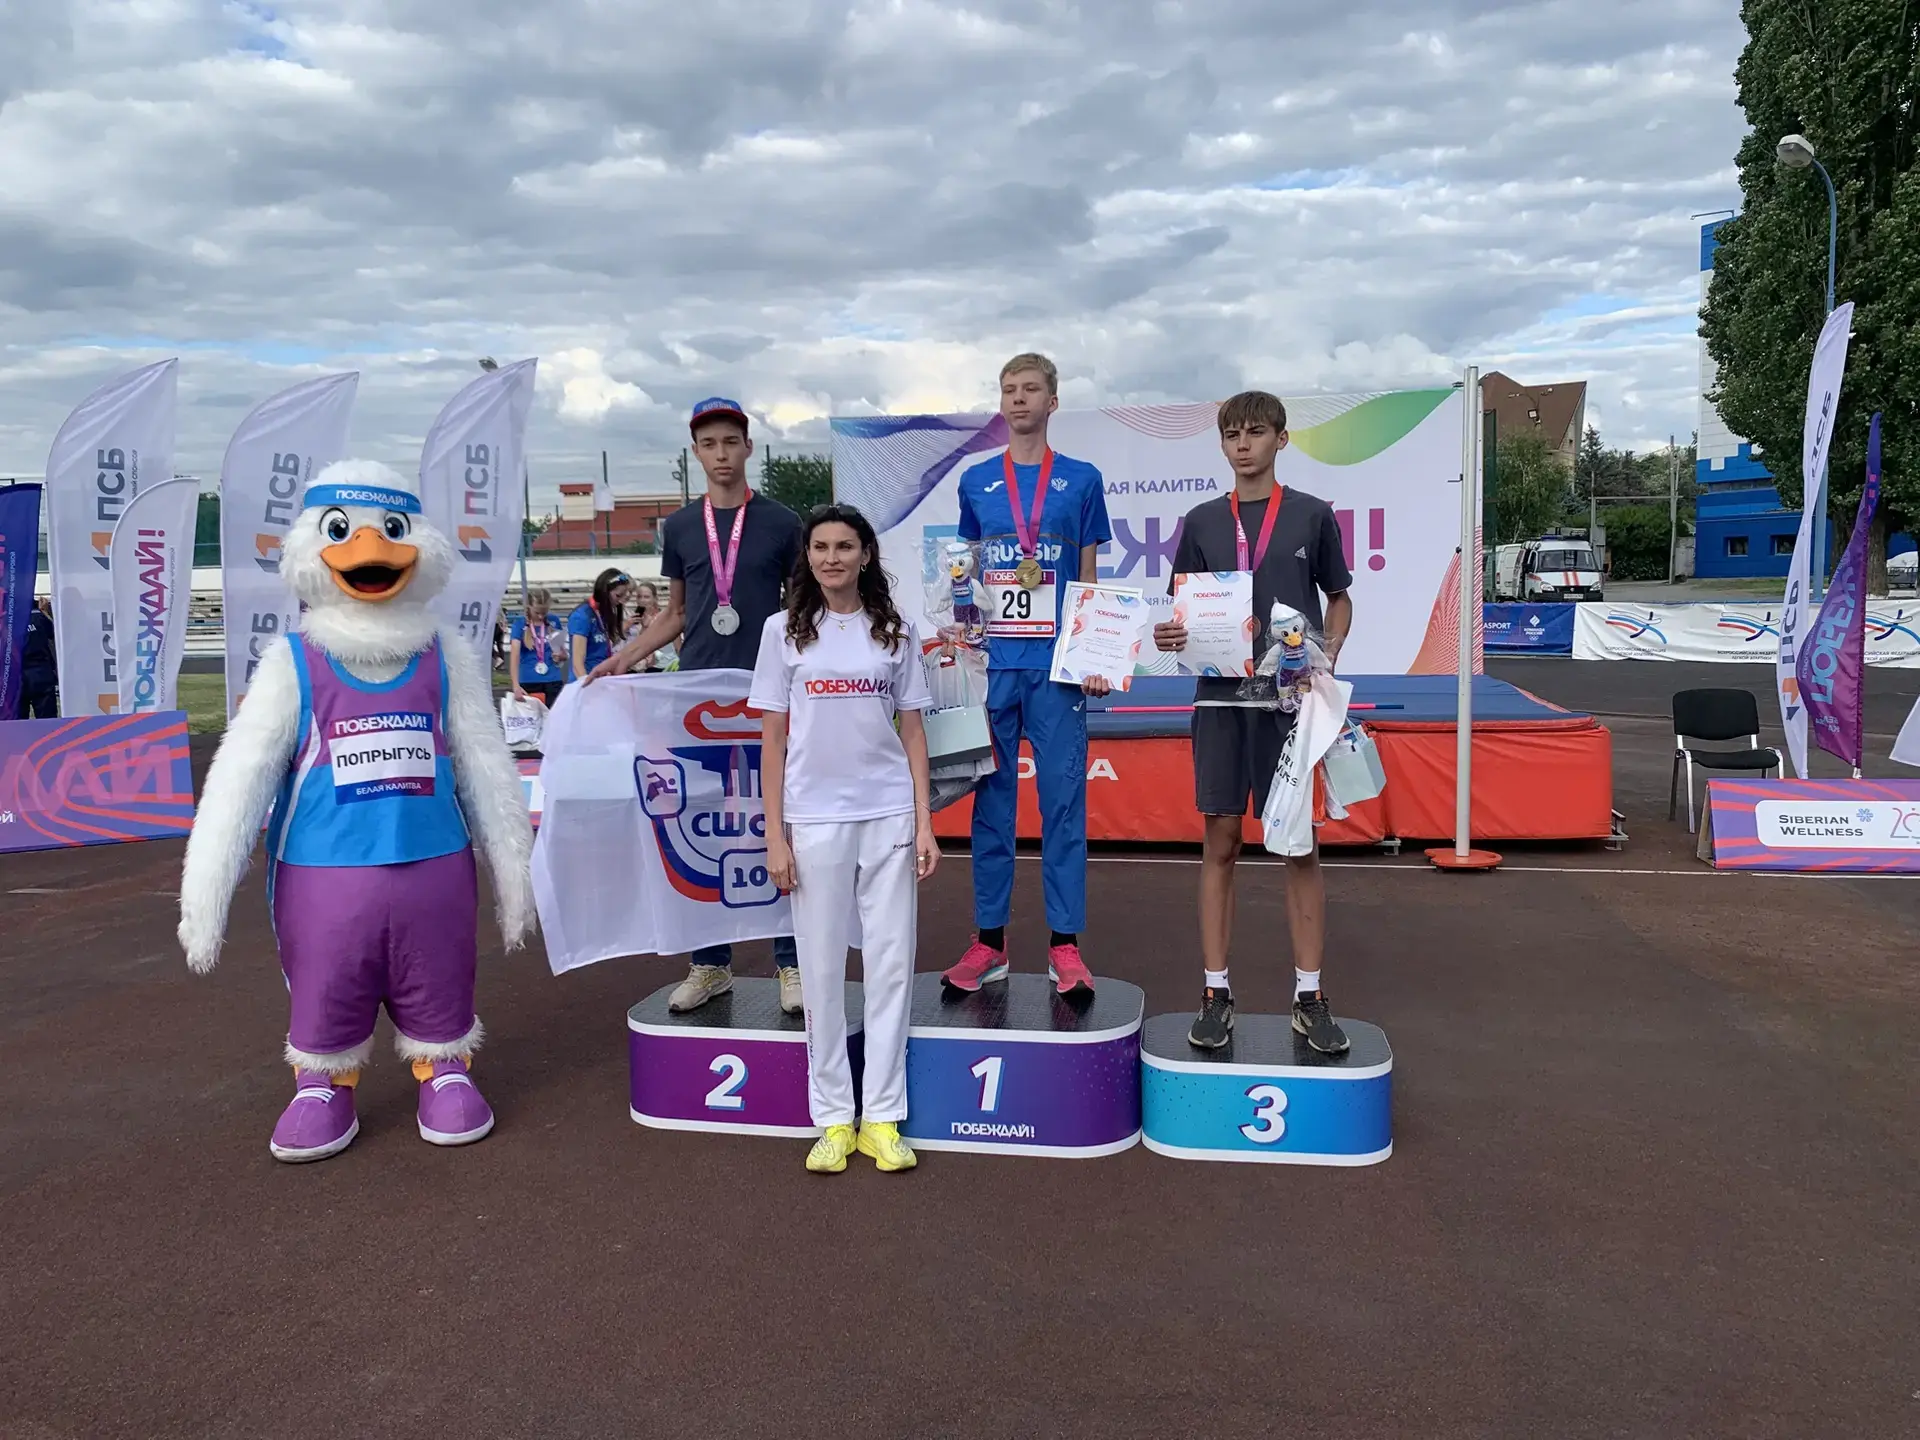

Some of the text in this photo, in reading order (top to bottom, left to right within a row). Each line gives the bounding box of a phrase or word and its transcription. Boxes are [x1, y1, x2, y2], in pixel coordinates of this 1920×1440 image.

[97, 448, 126, 522] ПСБ
[264, 452, 301, 526] ПСБ
[465, 444, 491, 516] ПСБ
[1135, 477, 1218, 494] КАЛИТВА
[335, 489, 408, 507] ПОБЕЖДАЙ!
[987, 542, 1063, 563] RUSSIA
[1002, 589, 1031, 619] 29
[1193, 590, 1233, 599] ПОБЕЖДАЙ!
[1094, 608, 1131, 621] ПОБЕЖДАЙ!
[1094, 626, 1121, 636] ДИПЛОМ
[335, 714, 427, 735] ПОБЕЖДАЙ!
[336, 747, 432, 768] ПОПРЫГУСЬ
[356, 782, 422, 796] БЕЛАЯ КАЛИТВА
[1779, 814, 1849, 825] SIBERIAN
[1780, 826, 1864, 837] WELLNESS
[731, 867, 768, 888] 10
[705, 1054, 746, 1109] 2
[971, 1057, 1004, 1112] 1
[1240, 1084, 1288, 1143] 3
[951, 1122, 1035, 1139] ПОБЕЖДАЙ!
